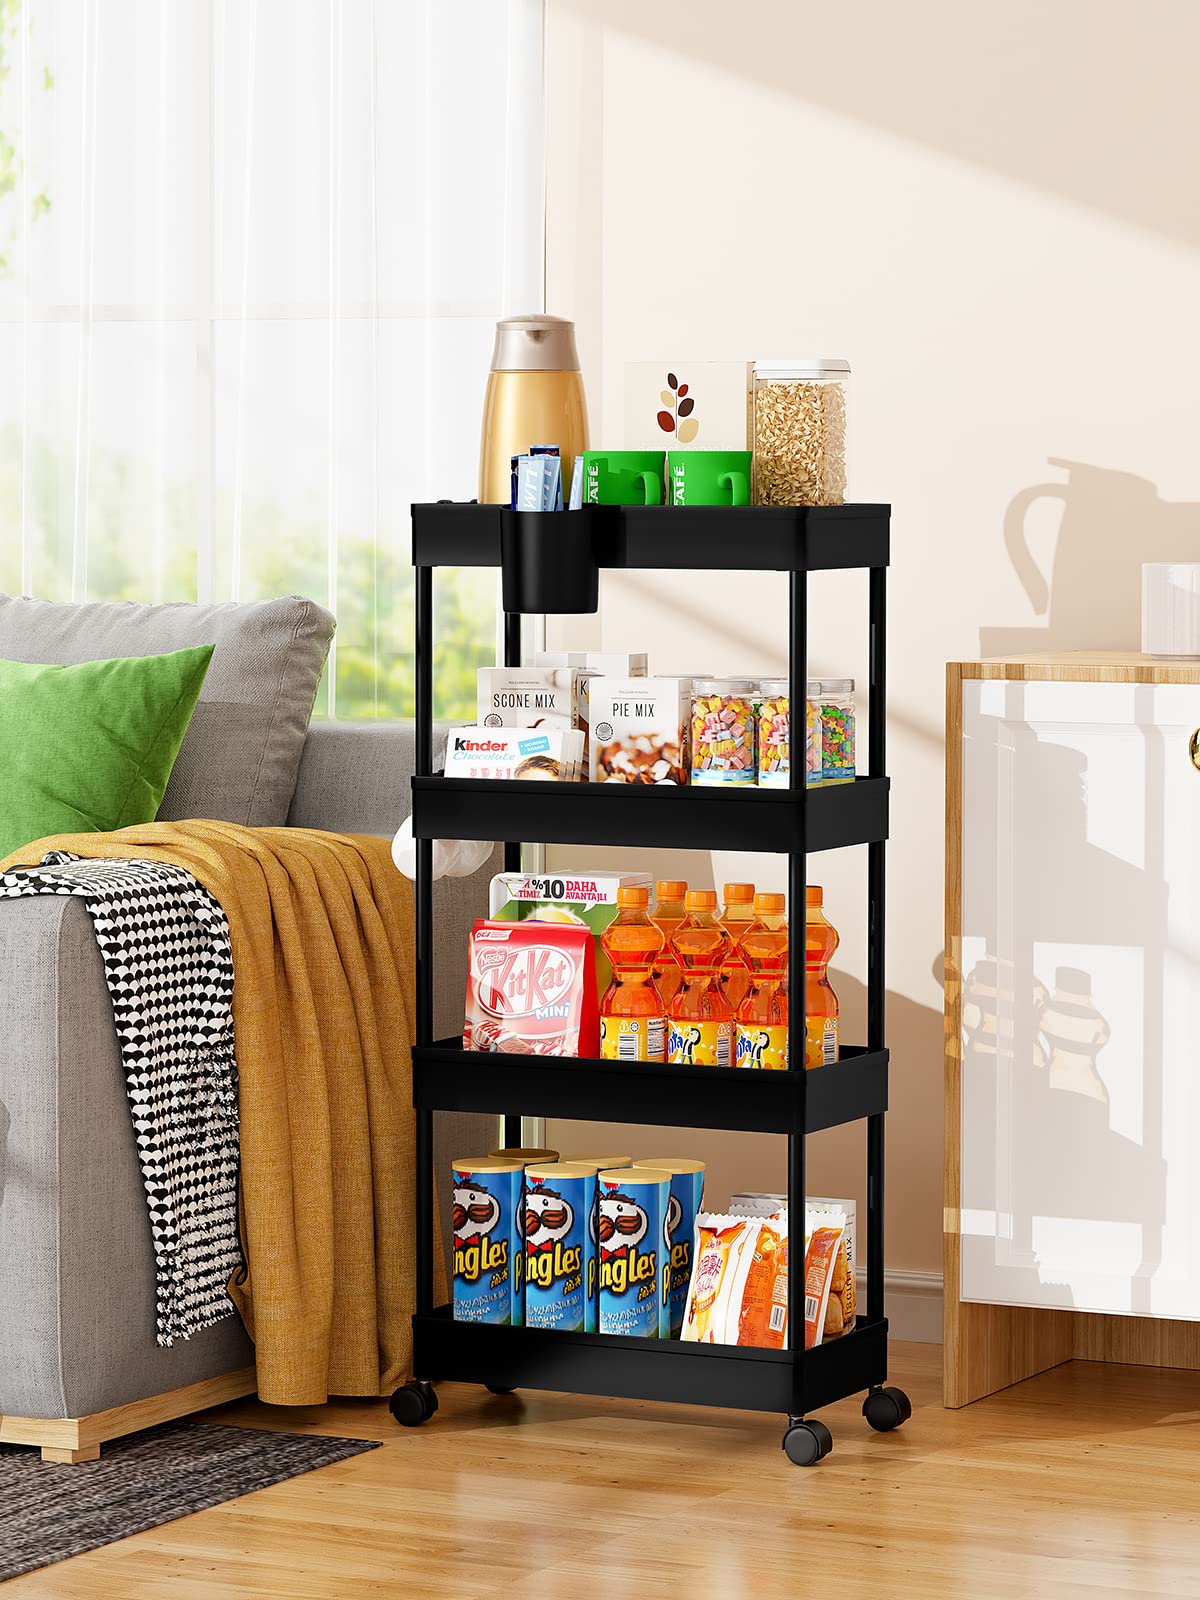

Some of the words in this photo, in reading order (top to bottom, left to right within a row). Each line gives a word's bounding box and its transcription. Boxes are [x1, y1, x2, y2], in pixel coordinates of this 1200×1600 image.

[493, 693, 530, 708] SCONE
[535, 693, 555, 708] MIX
[612, 702, 629, 717] PIE
[635, 703, 655, 718] MIX
[454, 737, 508, 751] Kinder
[453, 751, 516, 761] Chocolate
[565, 880, 597, 892] DAHA
[565, 892, 607, 902] AVANTAJLI
[453, 1236, 508, 1280] ngles
[600, 1248, 656, 1293] ngles
